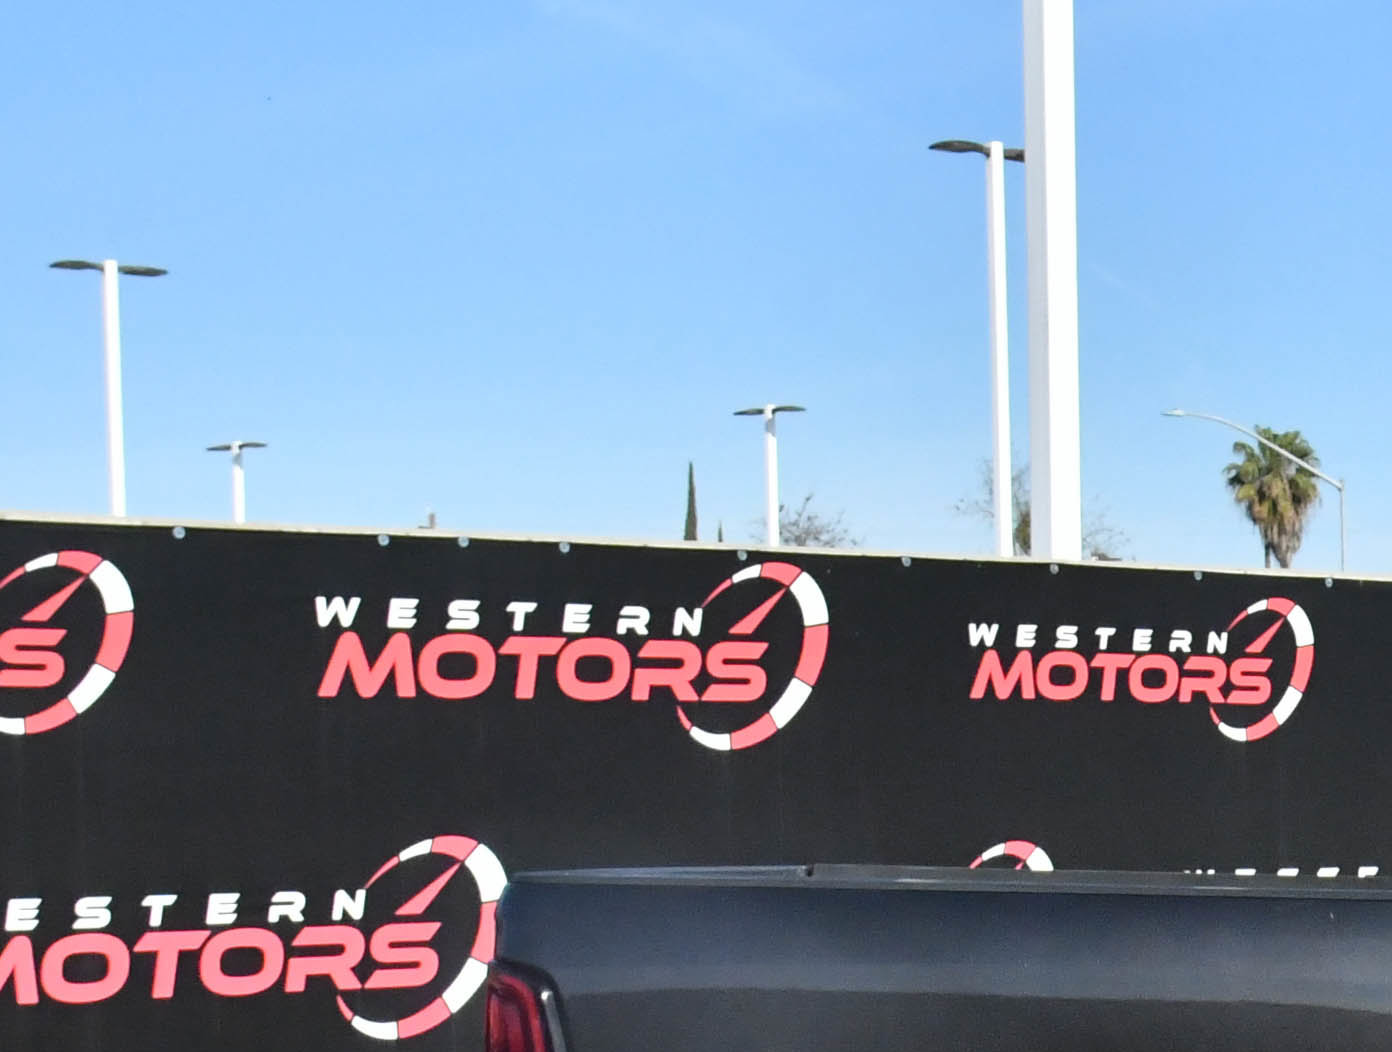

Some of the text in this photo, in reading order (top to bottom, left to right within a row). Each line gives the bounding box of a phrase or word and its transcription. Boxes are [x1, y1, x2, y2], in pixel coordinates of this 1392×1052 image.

[315, 596, 703, 637] WESTERN
[968, 623, 1229, 655] WESTERN
[317, 630, 769, 703] MOTORS
[969, 650, 1273, 705] MOTORS
[4, 889, 367, 932] ESTERN
